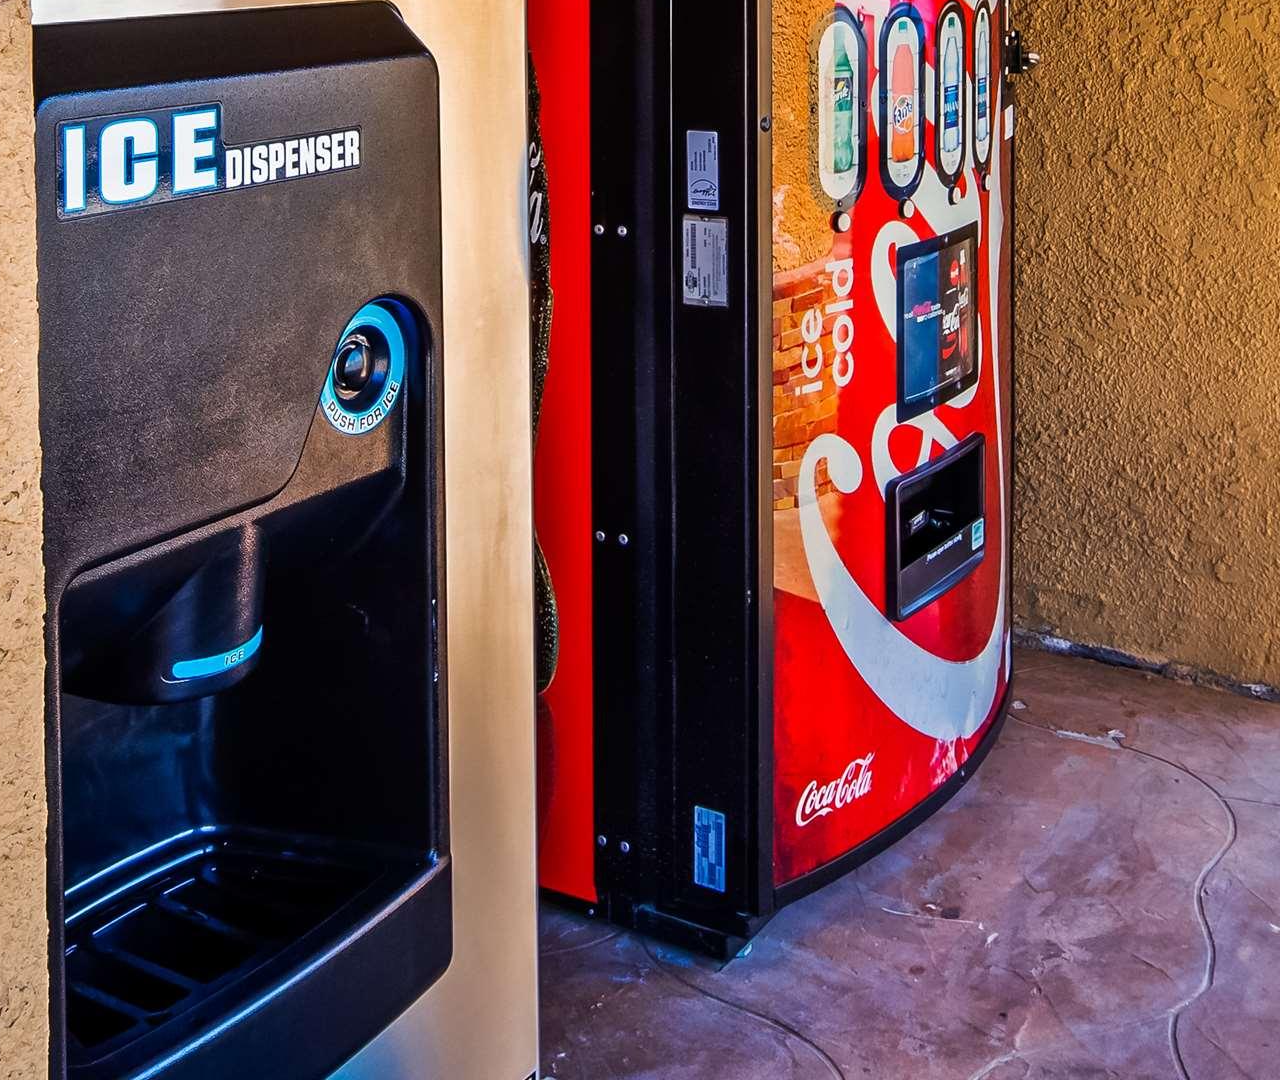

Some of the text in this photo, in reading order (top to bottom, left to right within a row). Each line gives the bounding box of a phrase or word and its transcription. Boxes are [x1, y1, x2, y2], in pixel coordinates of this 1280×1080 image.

[62, 108, 360, 213] ICE DISPENSER
[794, 307, 823, 396] ice
[825, 258, 854, 387] cold
[326, 382, 400, 430] PUSH FOR ICE
[225, 650, 245, 665] ICE
[795, 751, 876, 827] Coca-Cola
